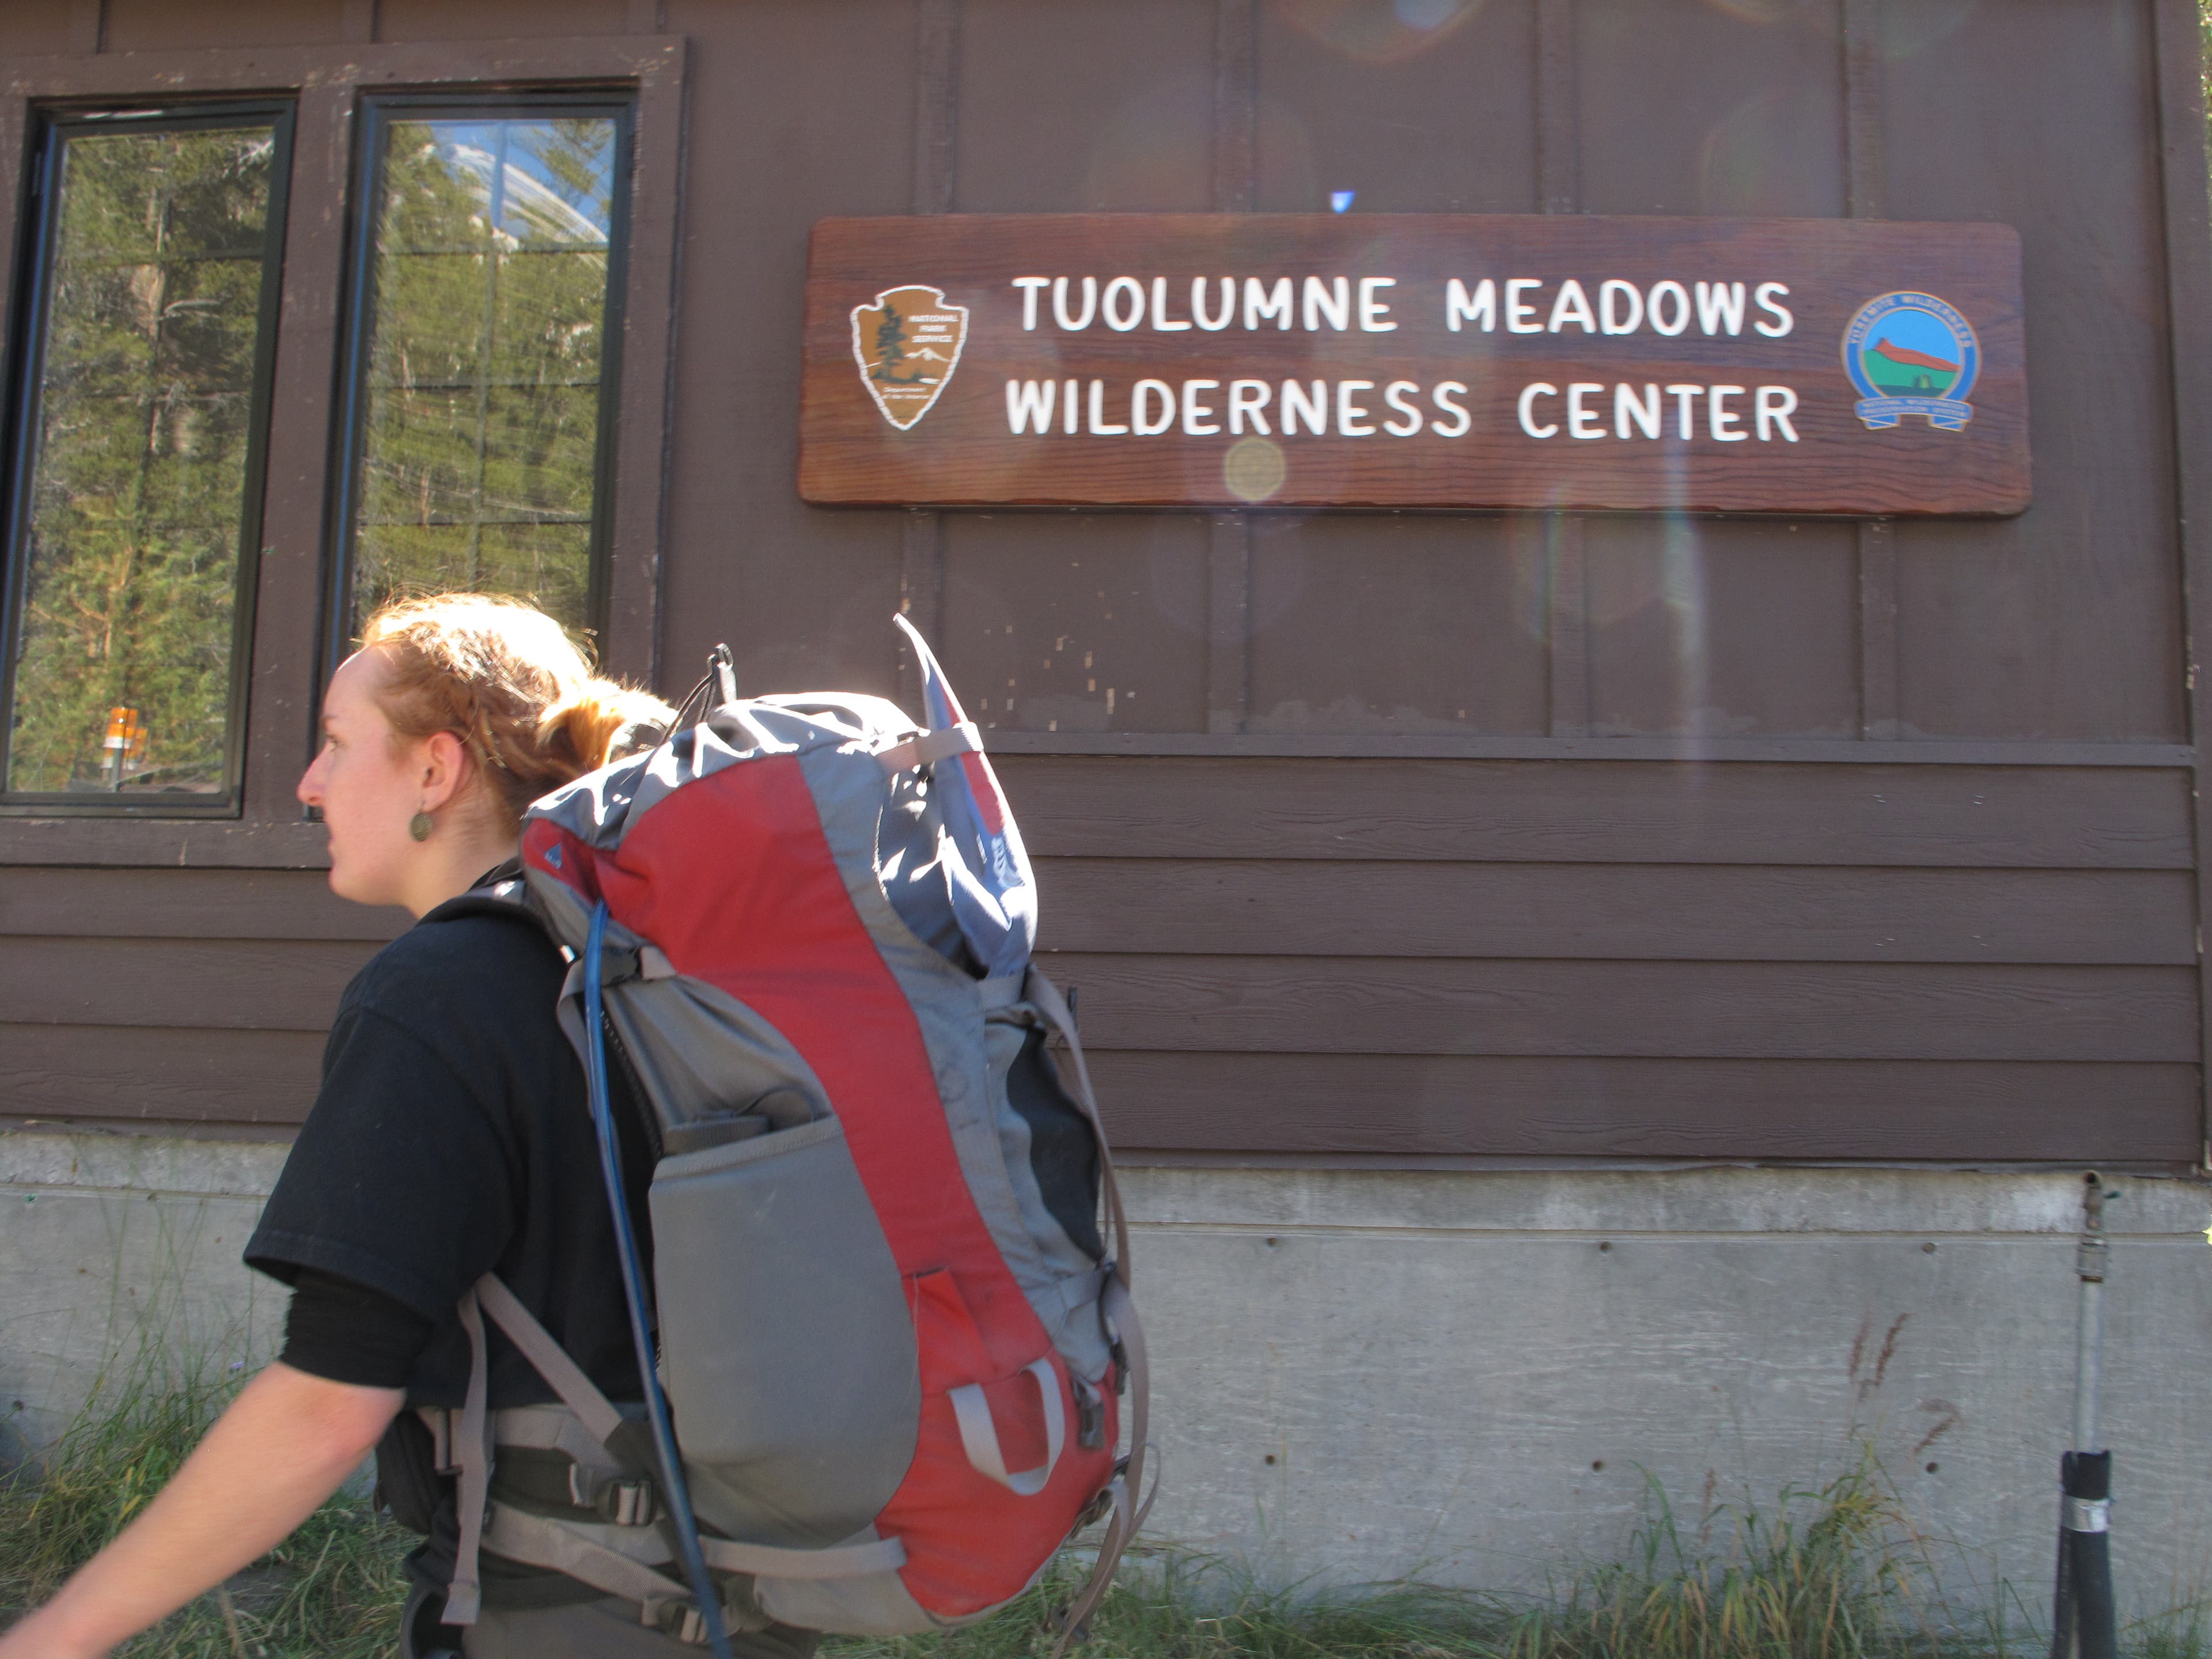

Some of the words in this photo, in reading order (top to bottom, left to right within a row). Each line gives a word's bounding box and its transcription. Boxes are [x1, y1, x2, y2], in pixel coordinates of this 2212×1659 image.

[908, 314, 959, 323] NATIONAL
[1011, 276, 1398, 332] TUOLUMNE
[1445, 278, 1794, 338] MEADOWS
[911, 334, 954, 343] SERVICE
[1005, 378, 1472, 438] WILDERNESS
[1517, 382, 1800, 443] CENTER
